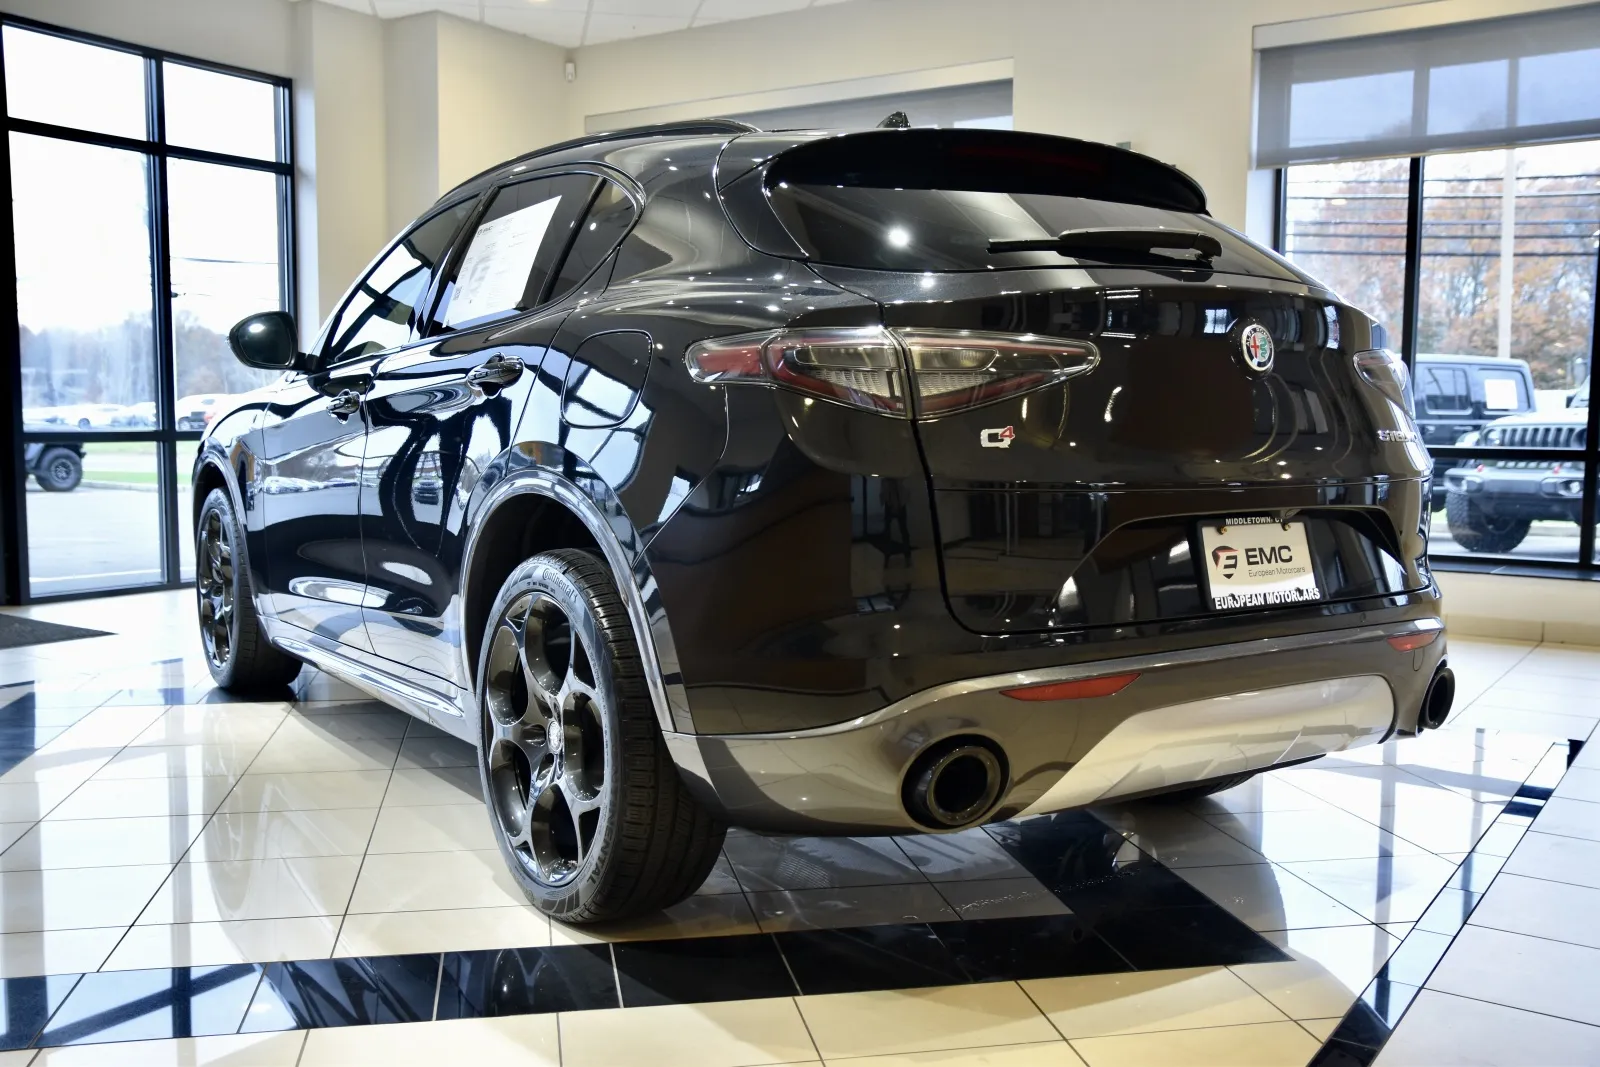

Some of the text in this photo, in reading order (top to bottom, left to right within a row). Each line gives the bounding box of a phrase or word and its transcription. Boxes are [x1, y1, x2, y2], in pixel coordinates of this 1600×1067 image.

[1245, 545, 1292, 565] EMC
[1248, 566, 1306, 578] European Motorcars
[542, 567, 575, 599] Continental
[1214, 587, 1321, 610] EUROPEAN MOTORCARS
